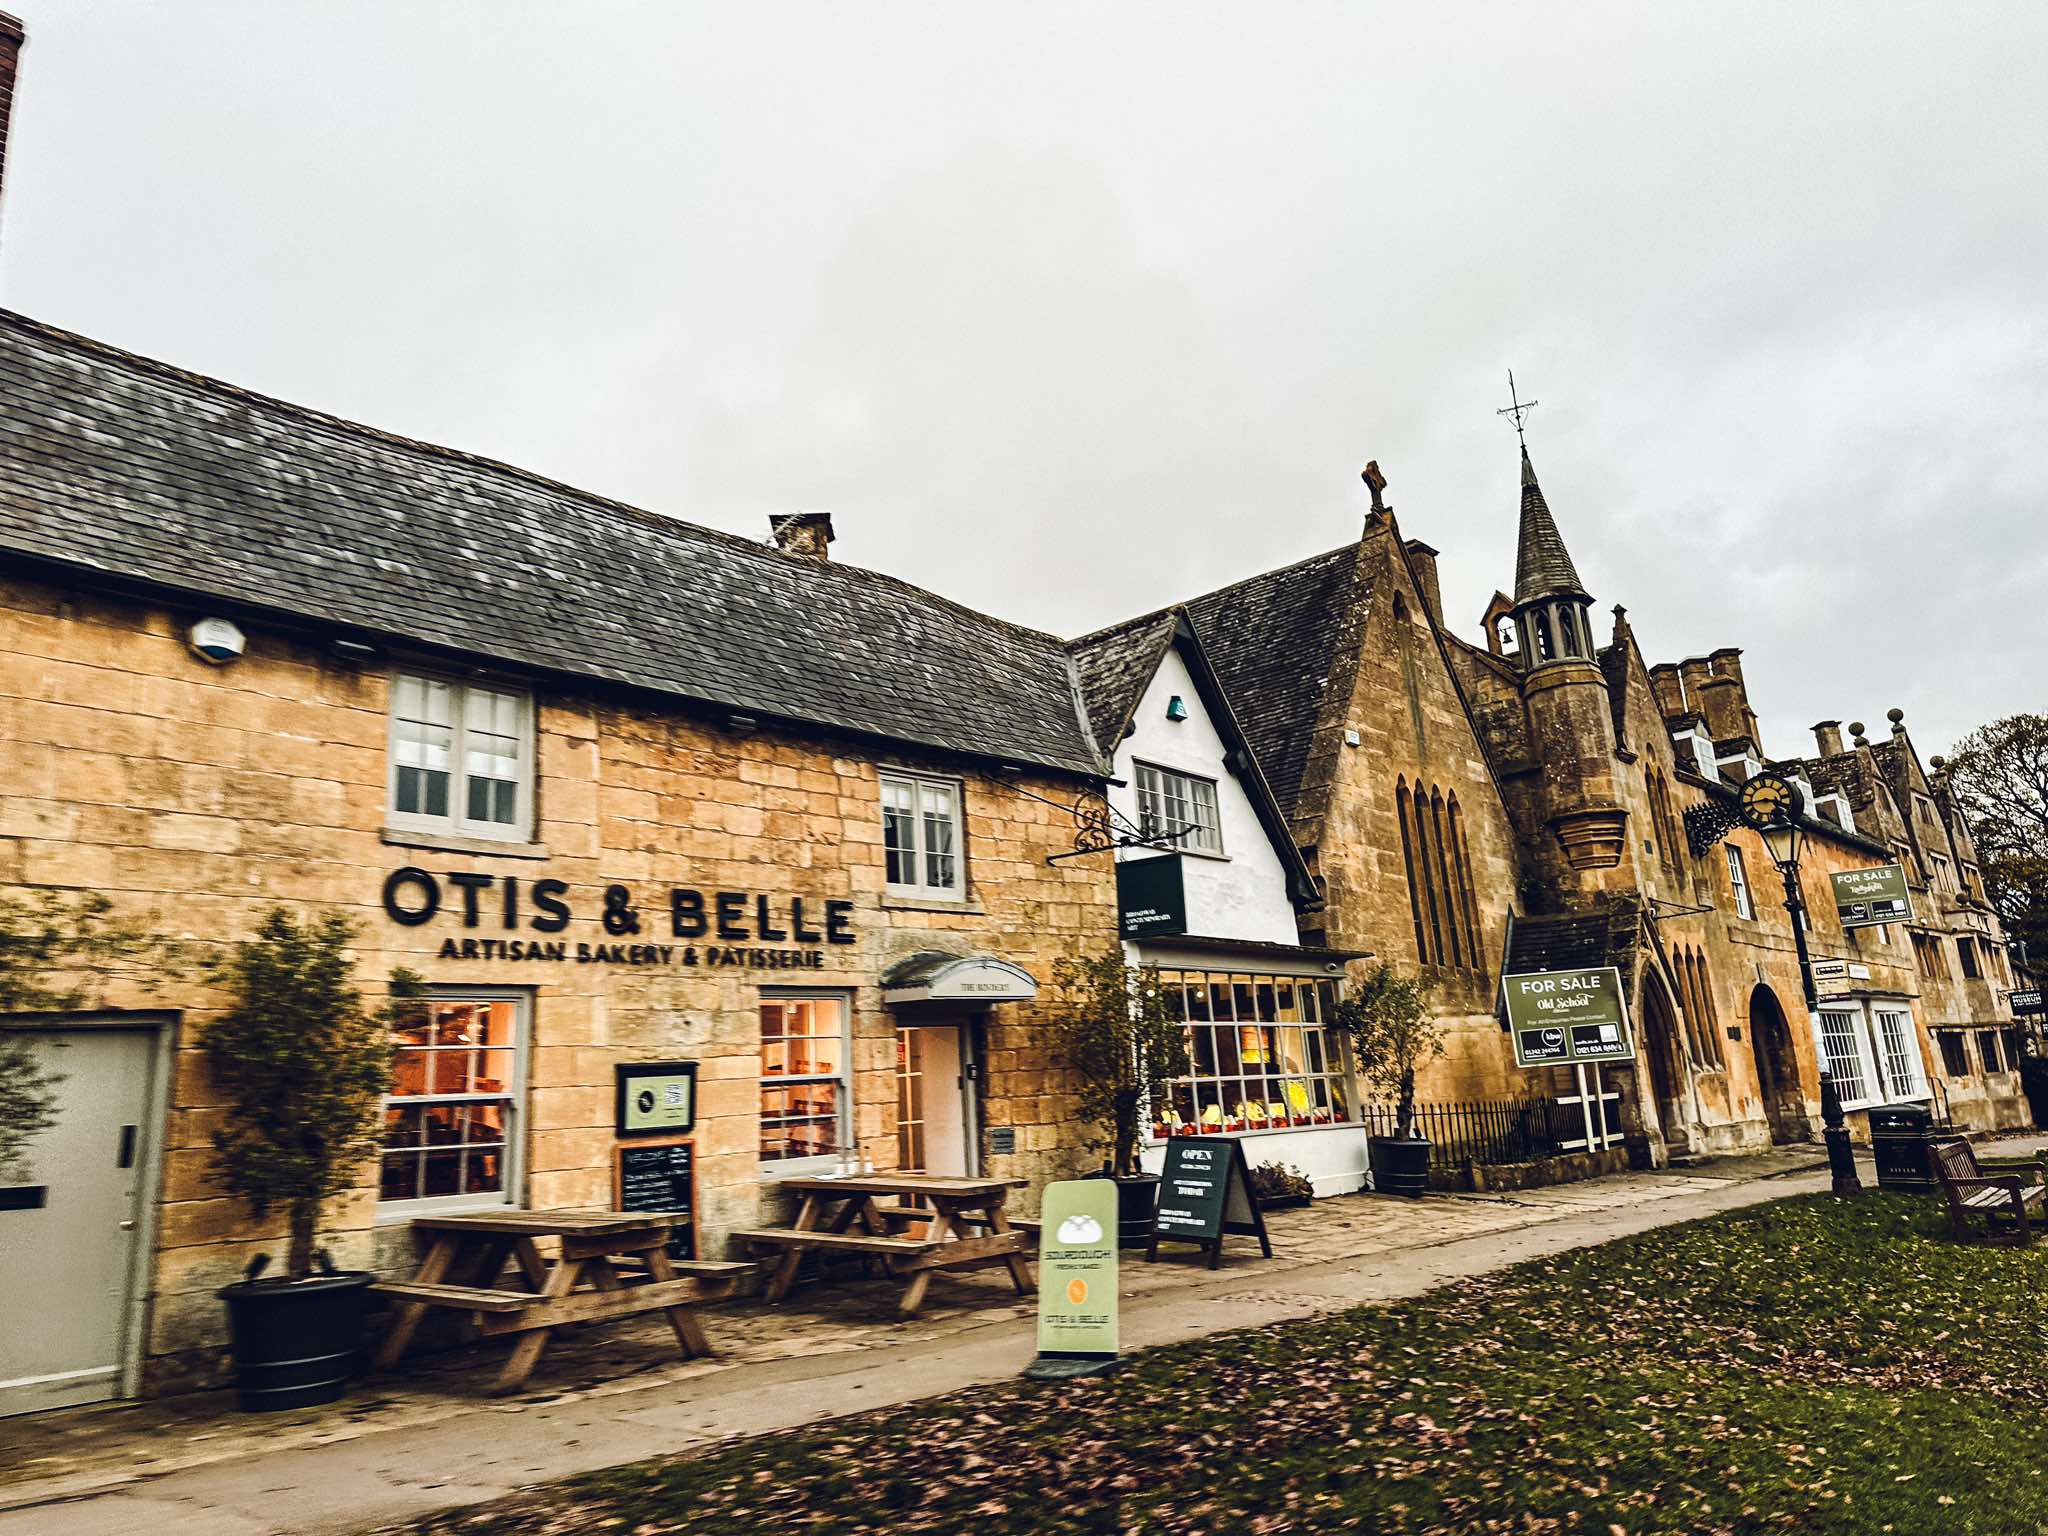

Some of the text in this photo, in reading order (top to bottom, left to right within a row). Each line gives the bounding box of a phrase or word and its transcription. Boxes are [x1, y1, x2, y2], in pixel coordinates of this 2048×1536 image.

[1837, 870, 1893, 884] FOR SALE
[382, 866, 857, 945] OTIS & BELLE
[438, 937, 825, 970] ARTISAN BAKERY & PATISSERIE
[1520, 976, 1600, 994] FOR SALE
[1537, 993, 1595, 1010] Old School
[2012, 996, 2042, 1004] MUSEUM
[1181, 1149, 1214, 1160] OPEN
